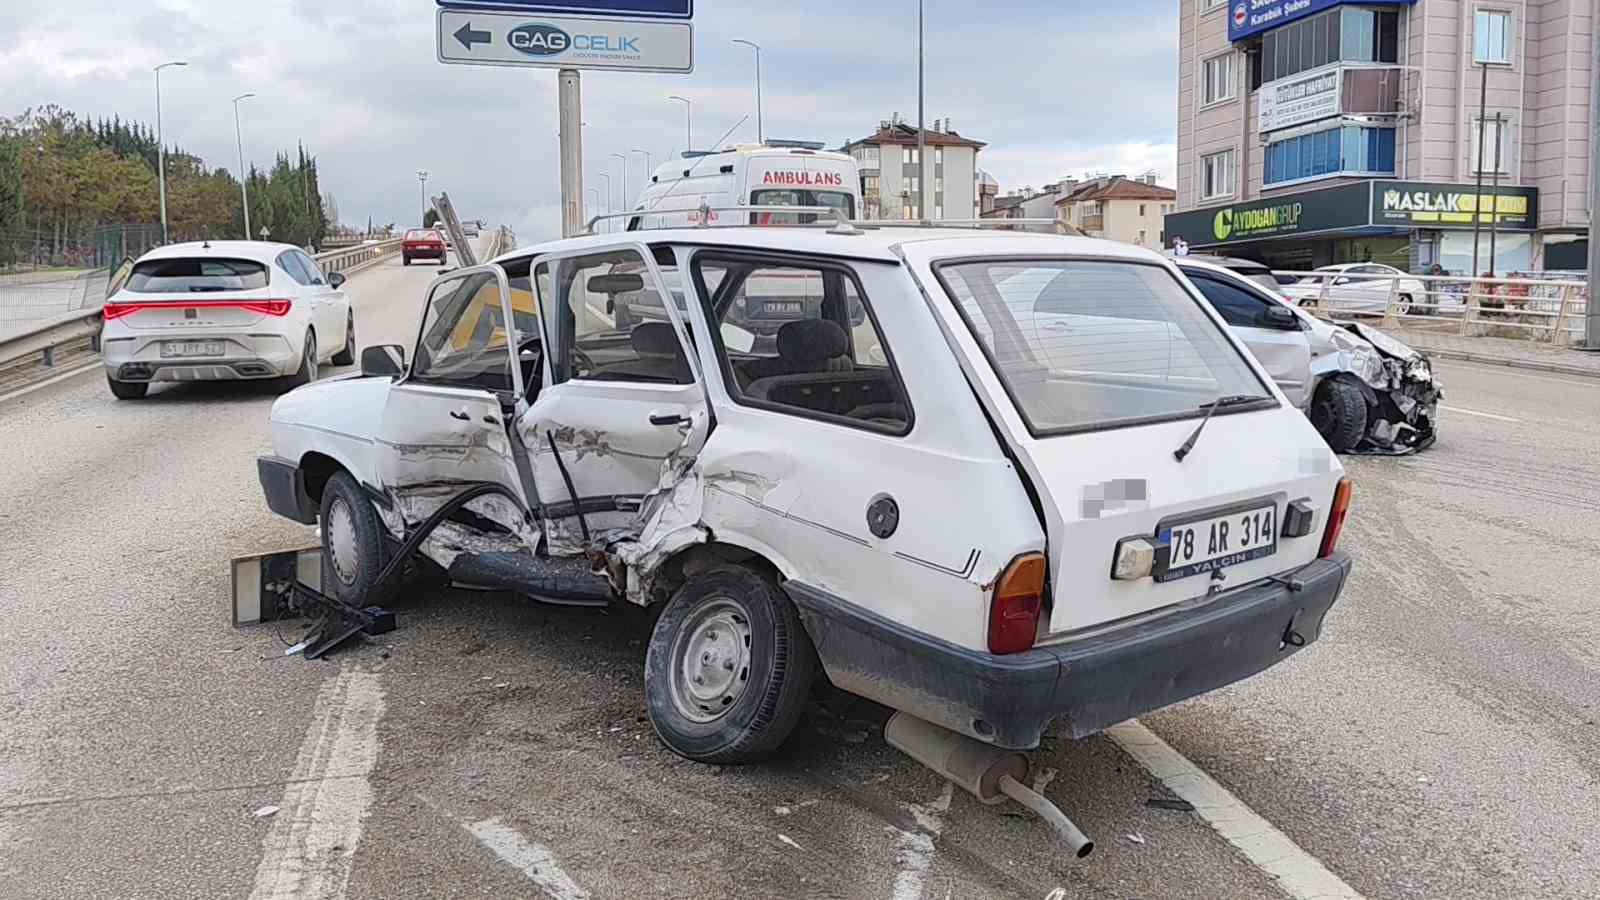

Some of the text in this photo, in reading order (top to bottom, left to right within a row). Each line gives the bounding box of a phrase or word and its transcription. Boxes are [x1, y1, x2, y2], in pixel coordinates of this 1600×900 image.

[1250, 6, 1282, 26] Karabük
[762, 170, 842, 186] AMBULANS
[1383, 190, 1460, 212] MASLAK
[1172, 510, 1272, 564] 78 AR 314
